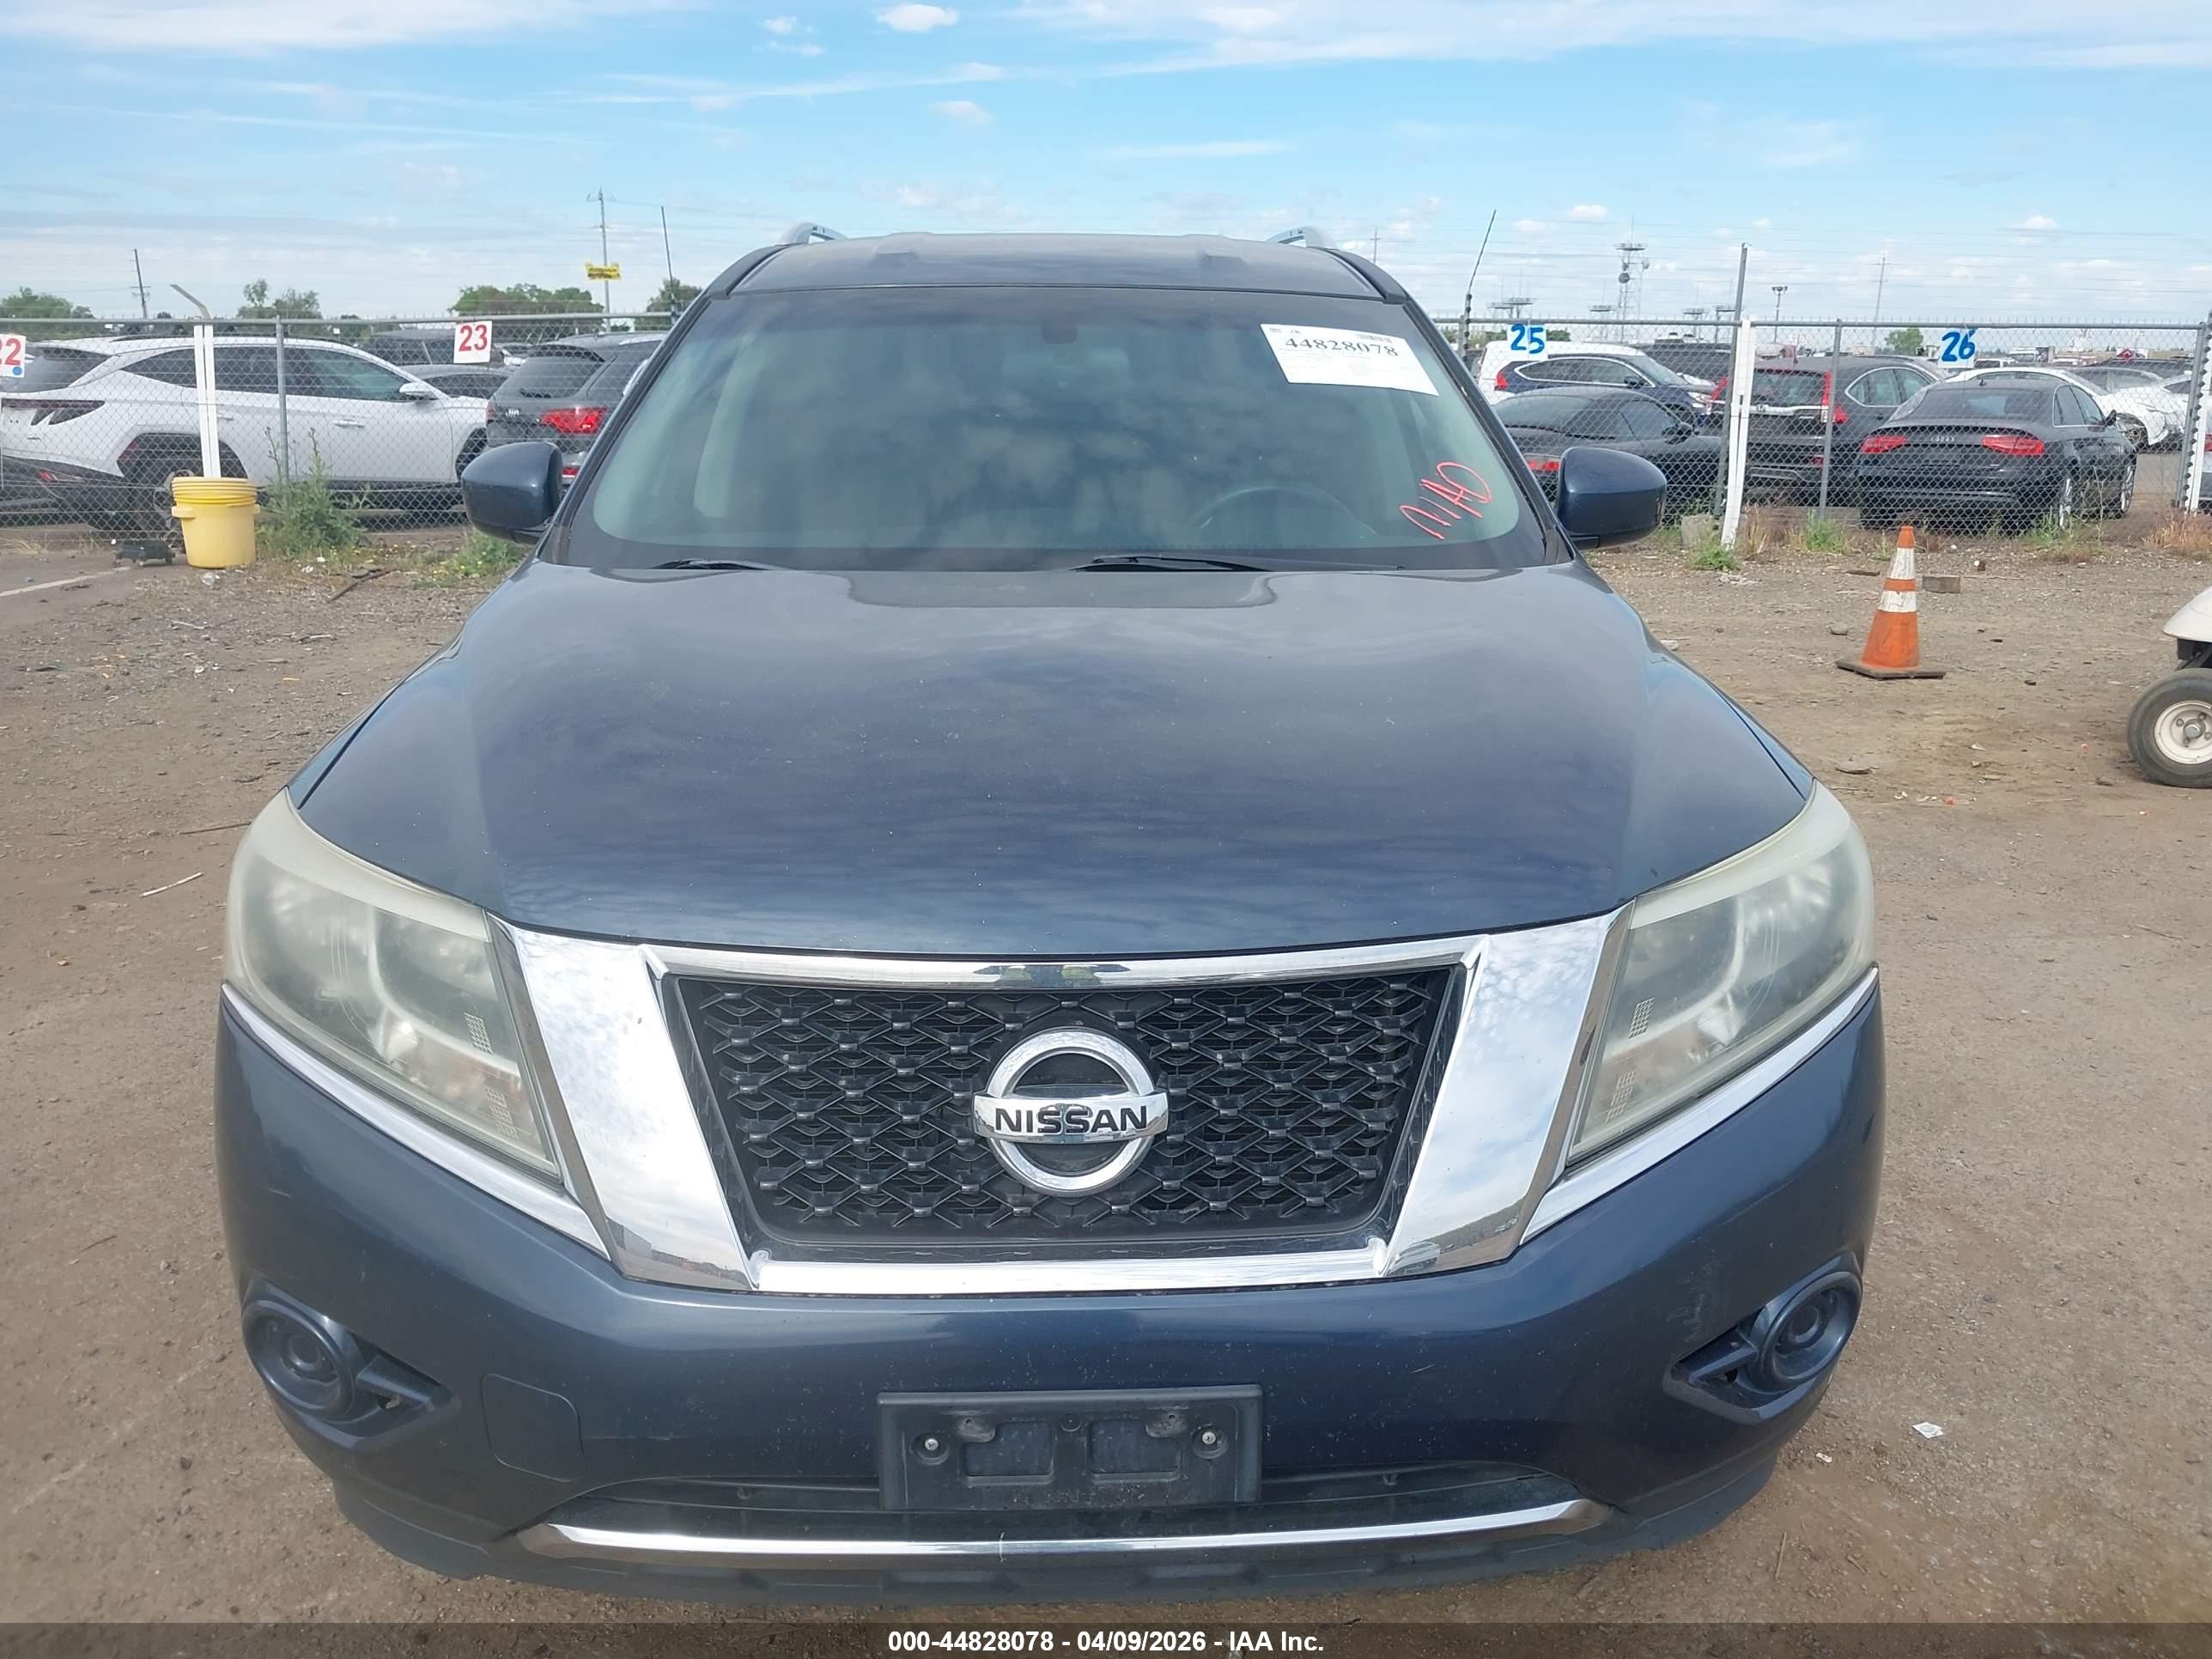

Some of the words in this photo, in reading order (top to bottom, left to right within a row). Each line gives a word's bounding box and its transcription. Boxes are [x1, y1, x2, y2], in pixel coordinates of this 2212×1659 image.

[0, 337, 21, 366] 2
[459, 324, 489, 352] 23
[1284, 337, 1400, 357] 44828078
[1510, 323, 1546, 355] 25
[1941, 329, 1976, 362] 26
[994, 1104, 1148, 1134] NISSAN
